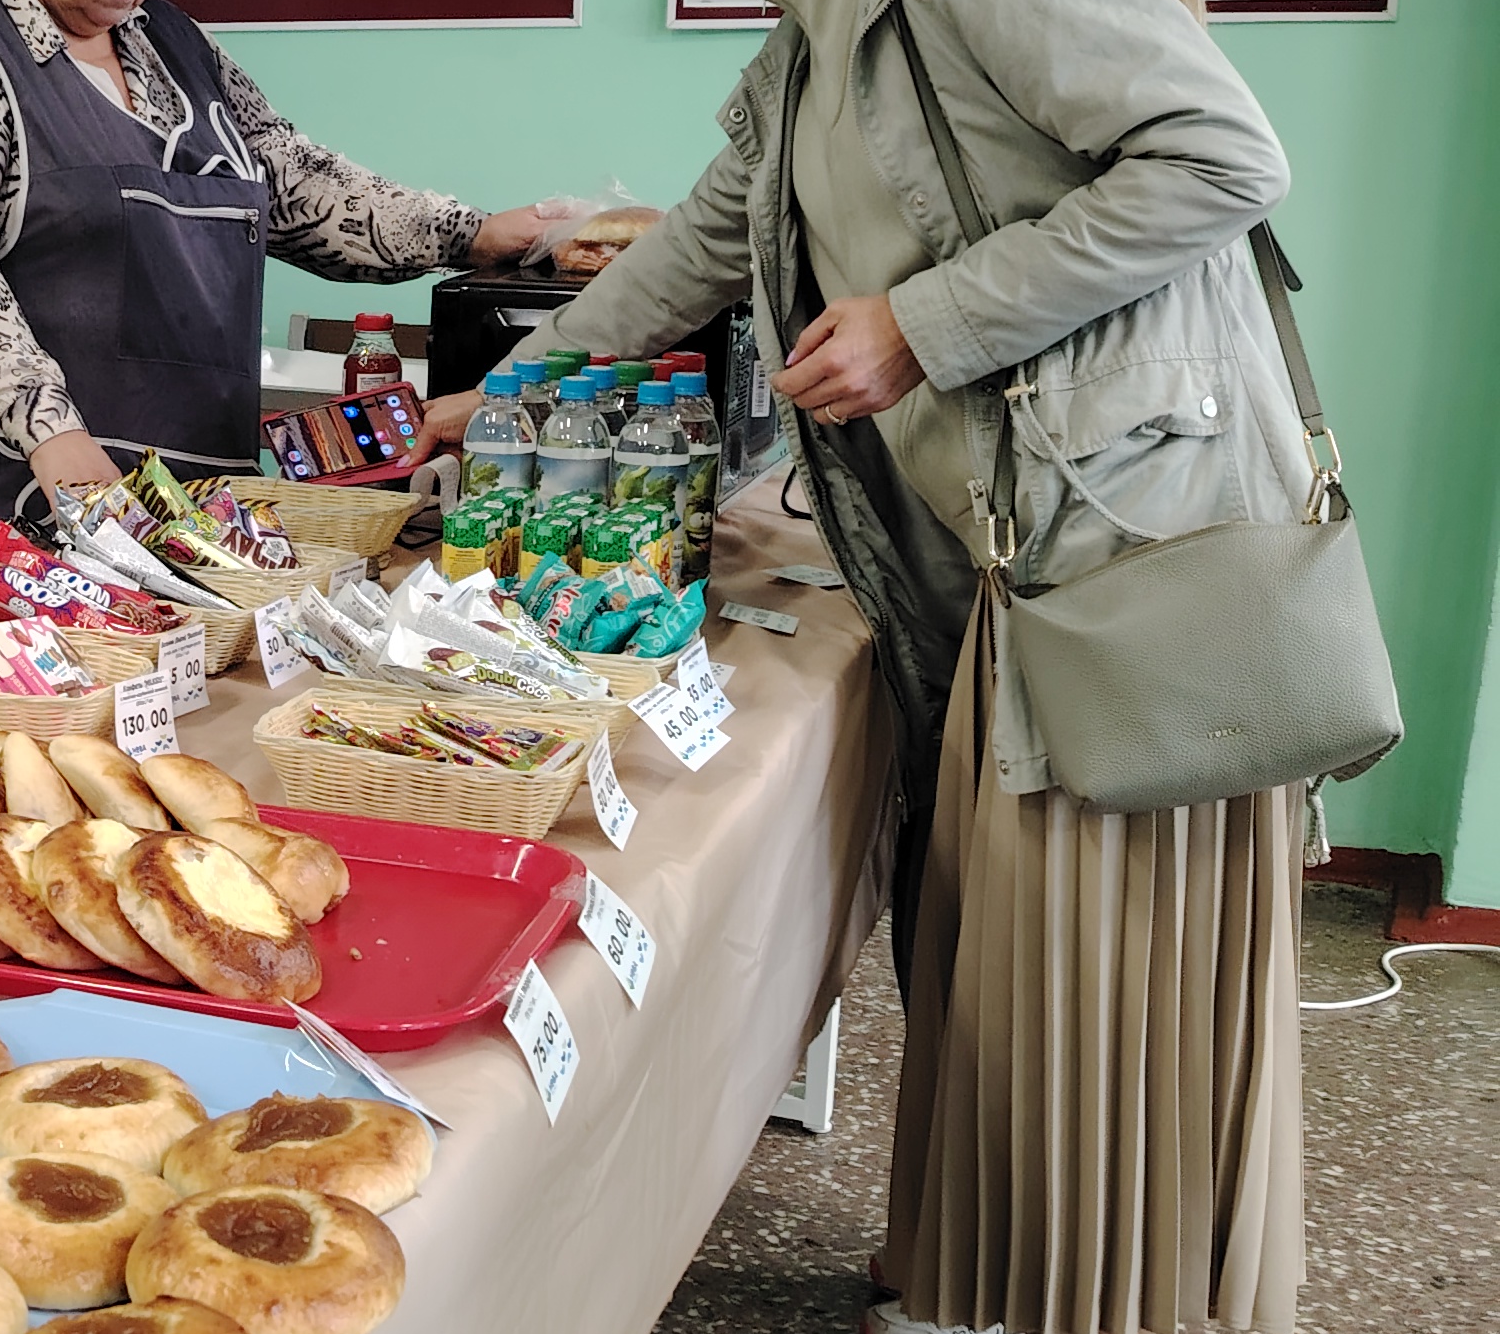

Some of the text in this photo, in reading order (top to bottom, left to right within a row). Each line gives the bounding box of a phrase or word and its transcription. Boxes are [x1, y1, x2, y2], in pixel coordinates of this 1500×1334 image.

[4, 566, 70, 607] BOOM
[45, 567, 111, 608] BOOM
[266, 637, 279, 655] 30
[185, 658, 200, 679] 00
[699, 673, 714, 693] 00
[122, 707, 168, 737] 130 00
[664, 706, 699, 740] 45 00
[608, 908, 631, 966] 60 00
[533, 1011, 559, 1072] 75 00
